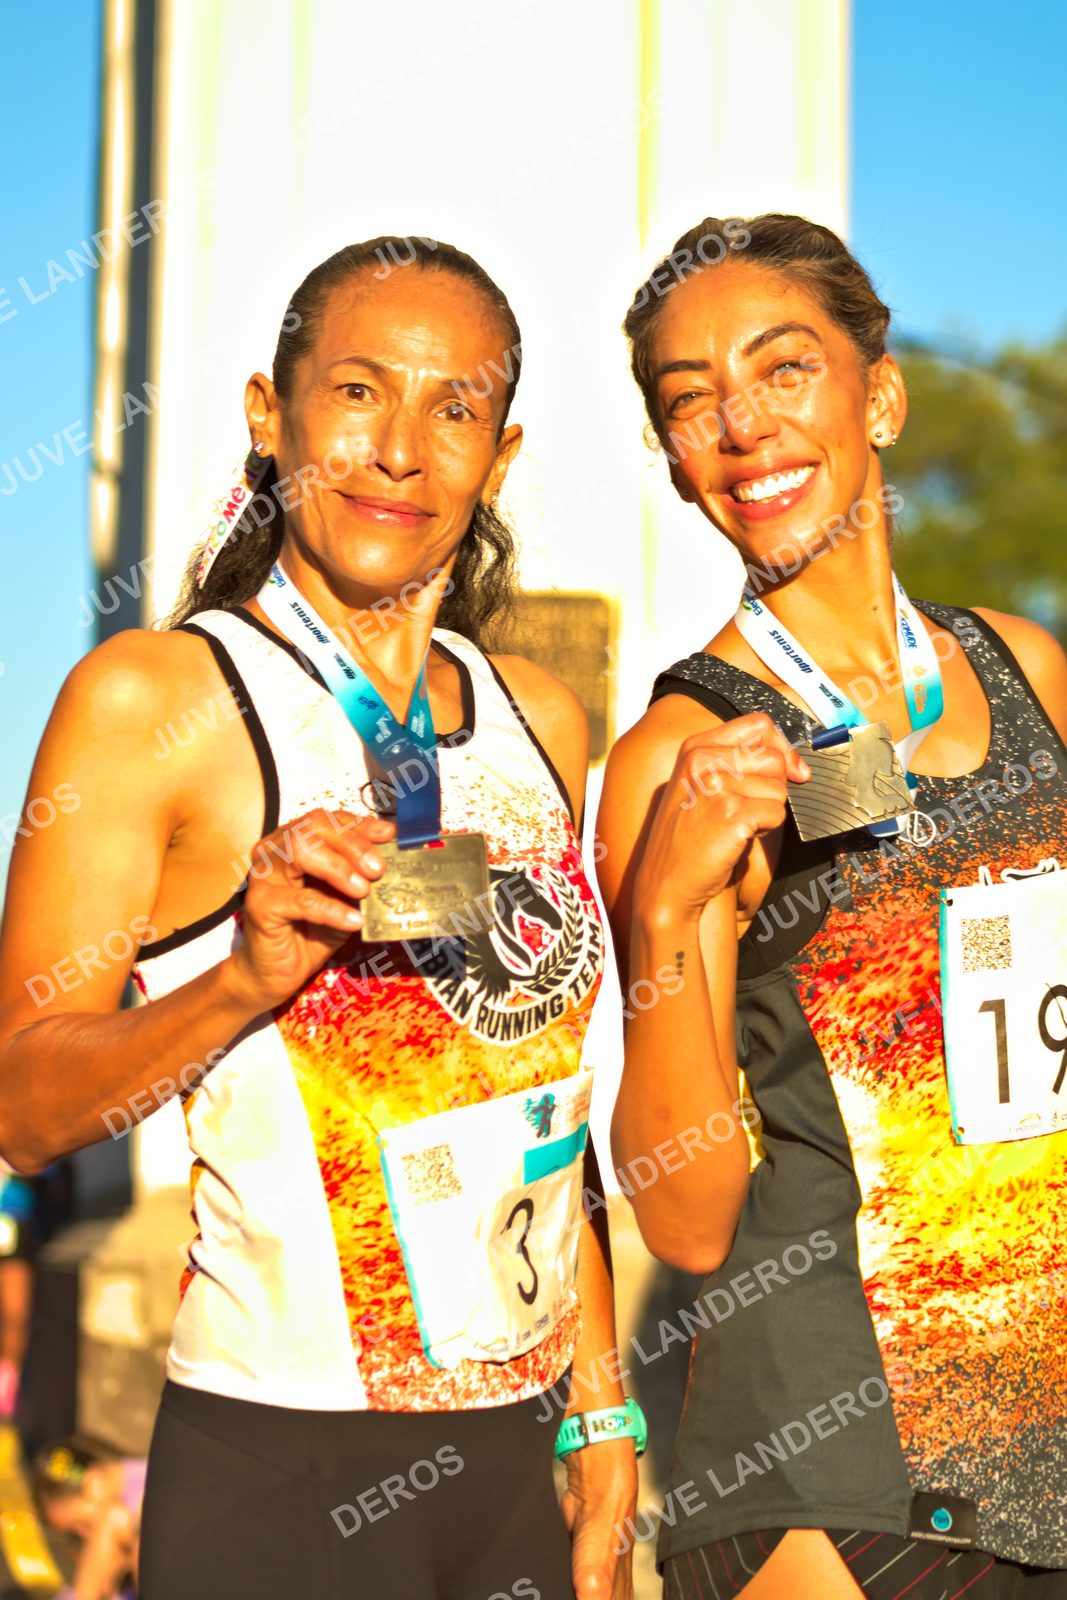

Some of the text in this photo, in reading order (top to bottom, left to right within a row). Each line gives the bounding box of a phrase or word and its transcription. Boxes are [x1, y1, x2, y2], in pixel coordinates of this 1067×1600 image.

[768, 629, 813, 674] dportenis
[475, 993, 565, 1042] RUNNING
[569, 920, 602, 1002] TEAM
[978, 983, 1067, 1105] 19
[501, 1197, 539, 1306] 3
